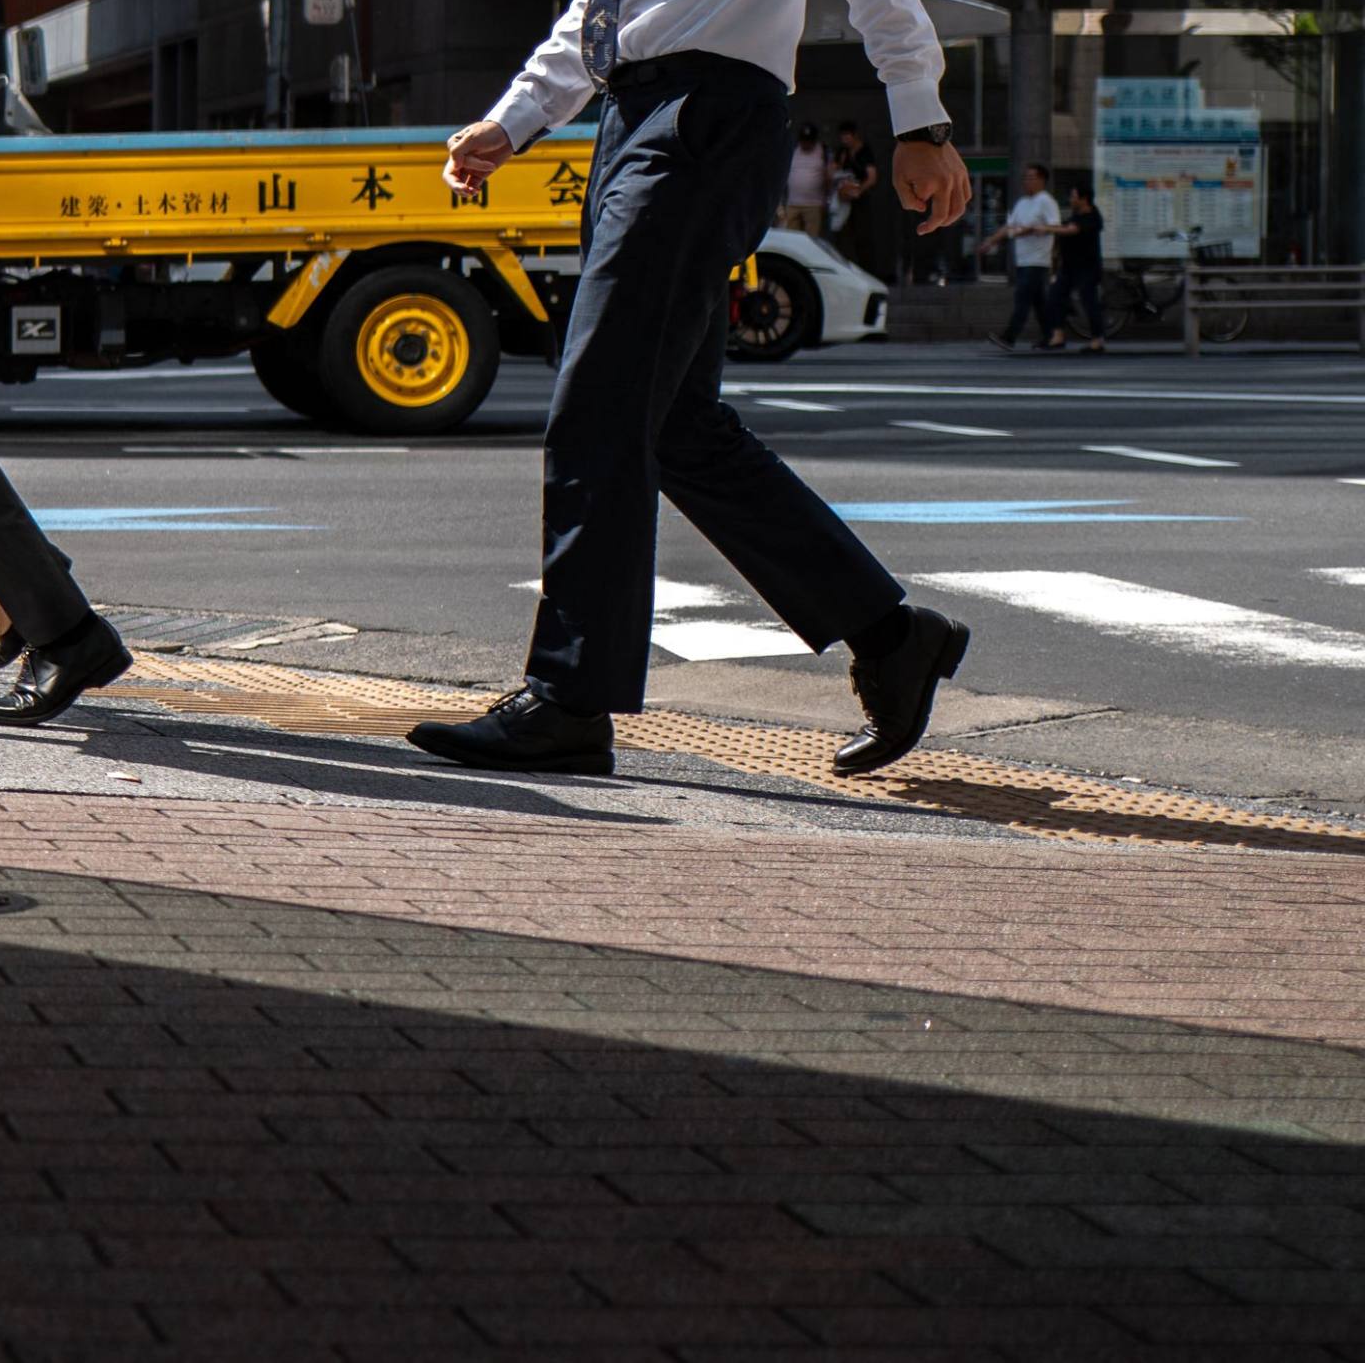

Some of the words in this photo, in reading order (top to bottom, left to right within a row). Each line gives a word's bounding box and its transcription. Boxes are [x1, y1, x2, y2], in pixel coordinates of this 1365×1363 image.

[60, 192, 229, 218] 建築・土木資材
